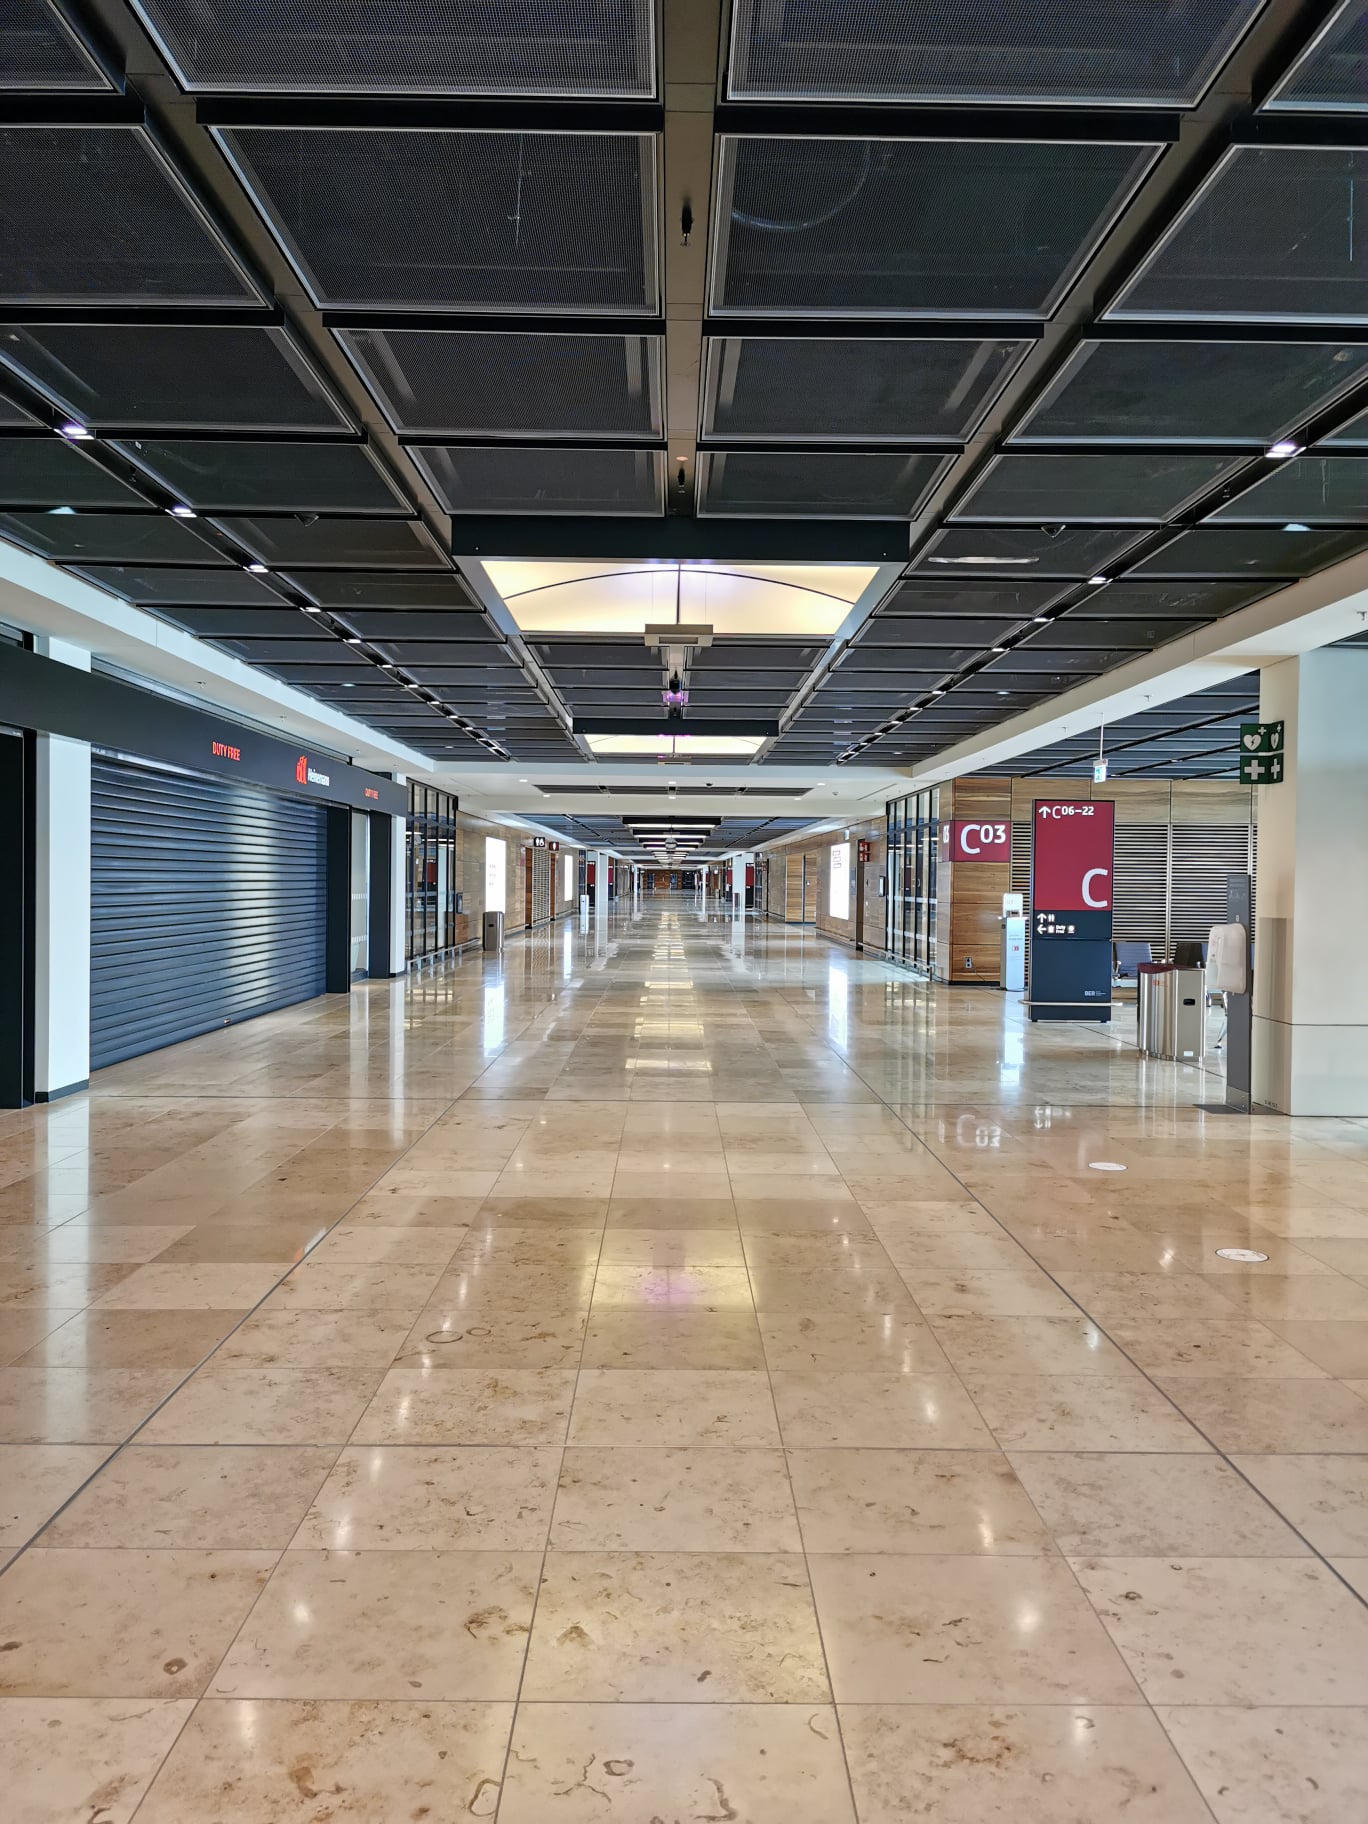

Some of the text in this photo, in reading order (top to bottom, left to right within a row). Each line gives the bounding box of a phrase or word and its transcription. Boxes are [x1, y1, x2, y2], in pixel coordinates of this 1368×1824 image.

[212, 741, 241, 761] DUTY FREE
[960, 824, 1007, 855] C03
[1081, 867, 1109, 908] C
